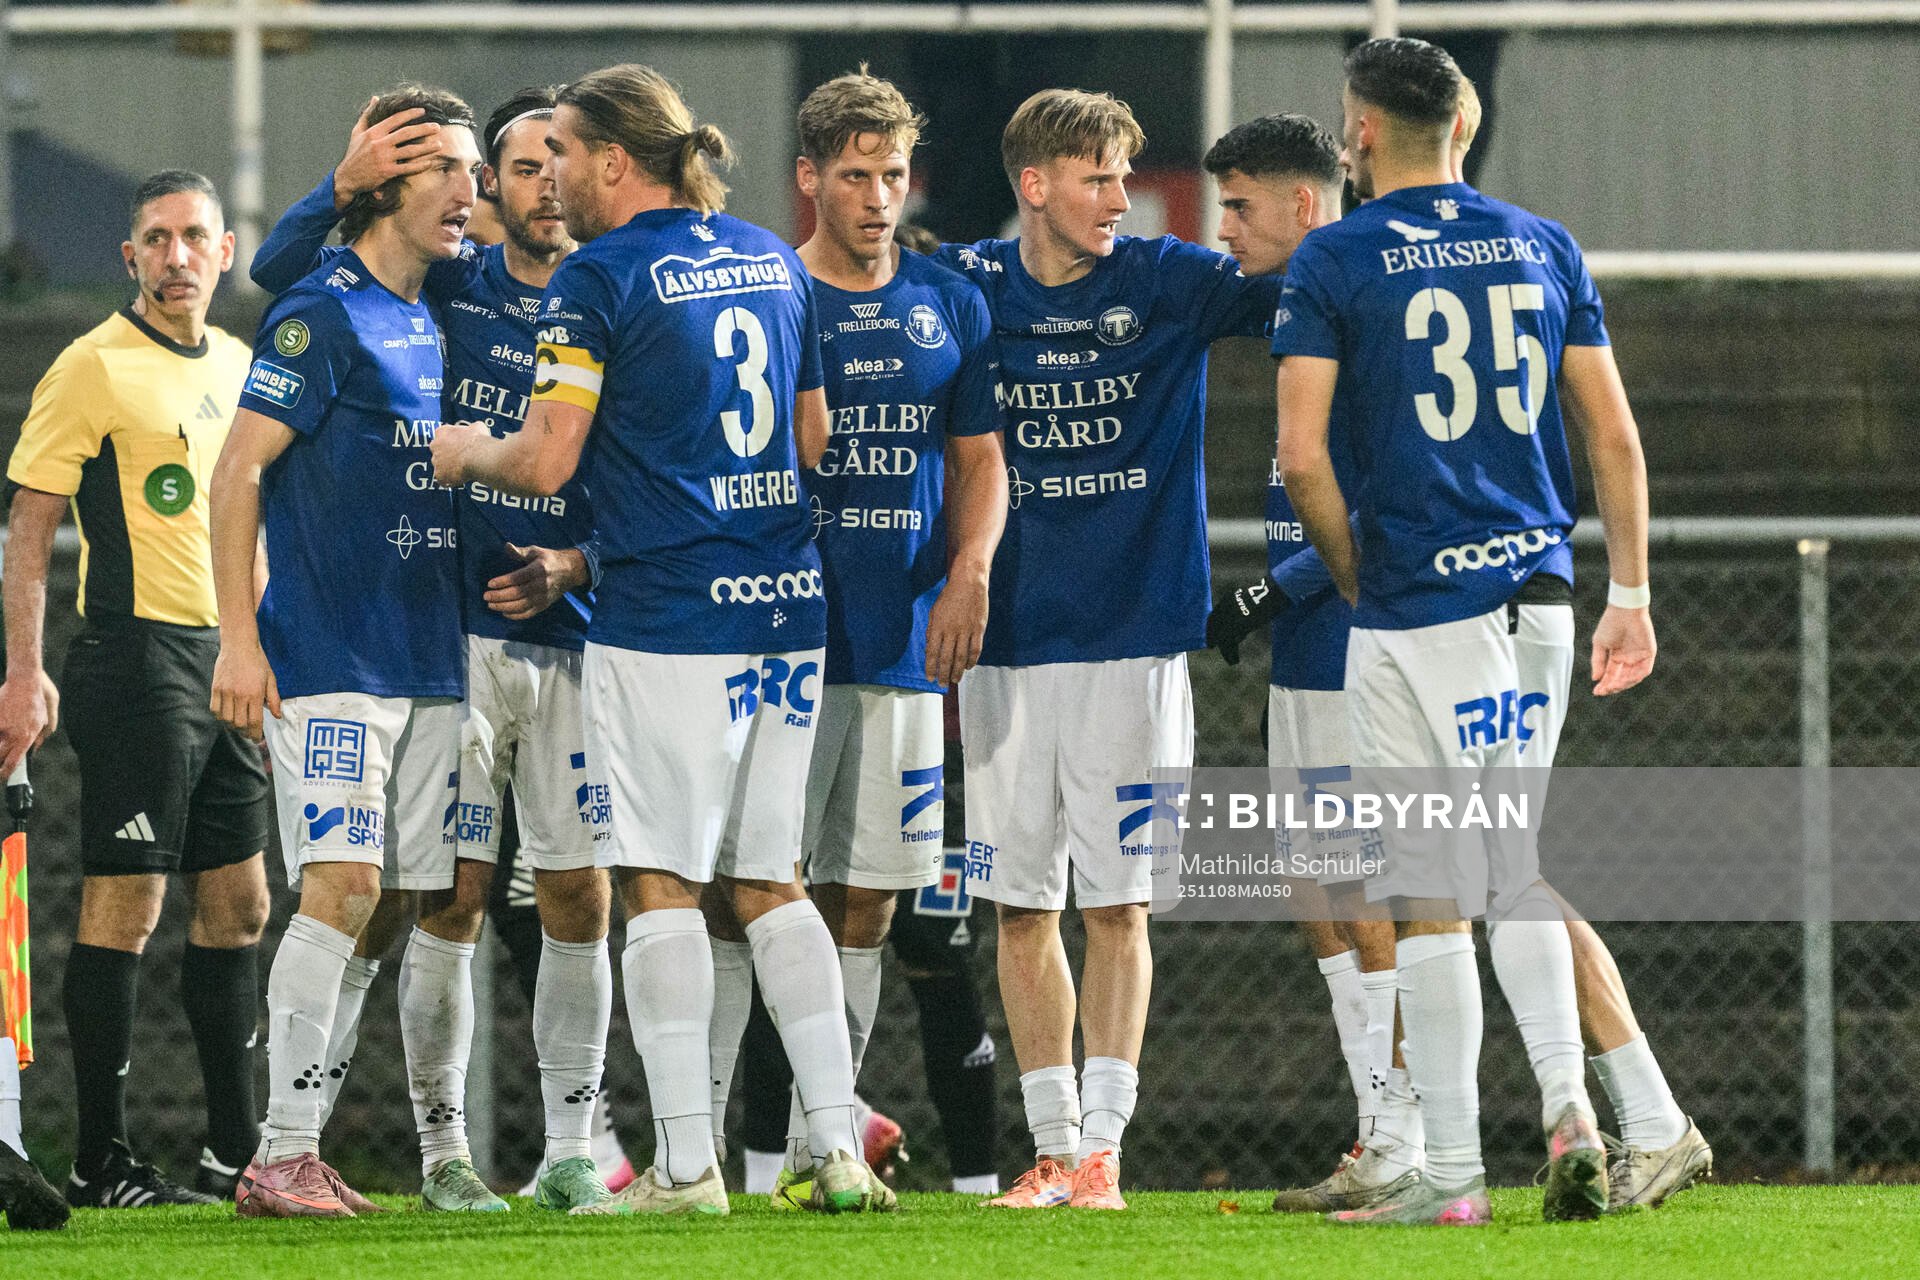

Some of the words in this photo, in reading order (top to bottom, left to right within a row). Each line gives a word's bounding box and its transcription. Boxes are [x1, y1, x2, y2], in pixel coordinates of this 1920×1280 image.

[1381, 236, 1546, 275] ERIKSBERG
[662, 262, 787, 296] ÄLVSBYHUS
[451, 300, 489, 316] CRAFT
[836, 318, 900, 333] TRELLEBORG
[1031, 319, 1093, 334] TRELLEBORG
[490, 344, 534, 368] akea
[844, 358, 884, 375] akea
[1037, 350, 1080, 365] akea
[1405, 283, 1549, 442] 35
[251, 366, 300, 394] UNIBET
[533, 348, 559, 395] C
[713, 306, 775, 458] 3
[1017, 413, 1122, 448] GÅRD
[815, 438, 917, 477] GÅRD
[162, 478, 178, 501] S
[709, 469, 798, 511] WEBERG
[785, 713, 811, 729] Rail
[1120, 844, 1168, 857] Trelleborgs
